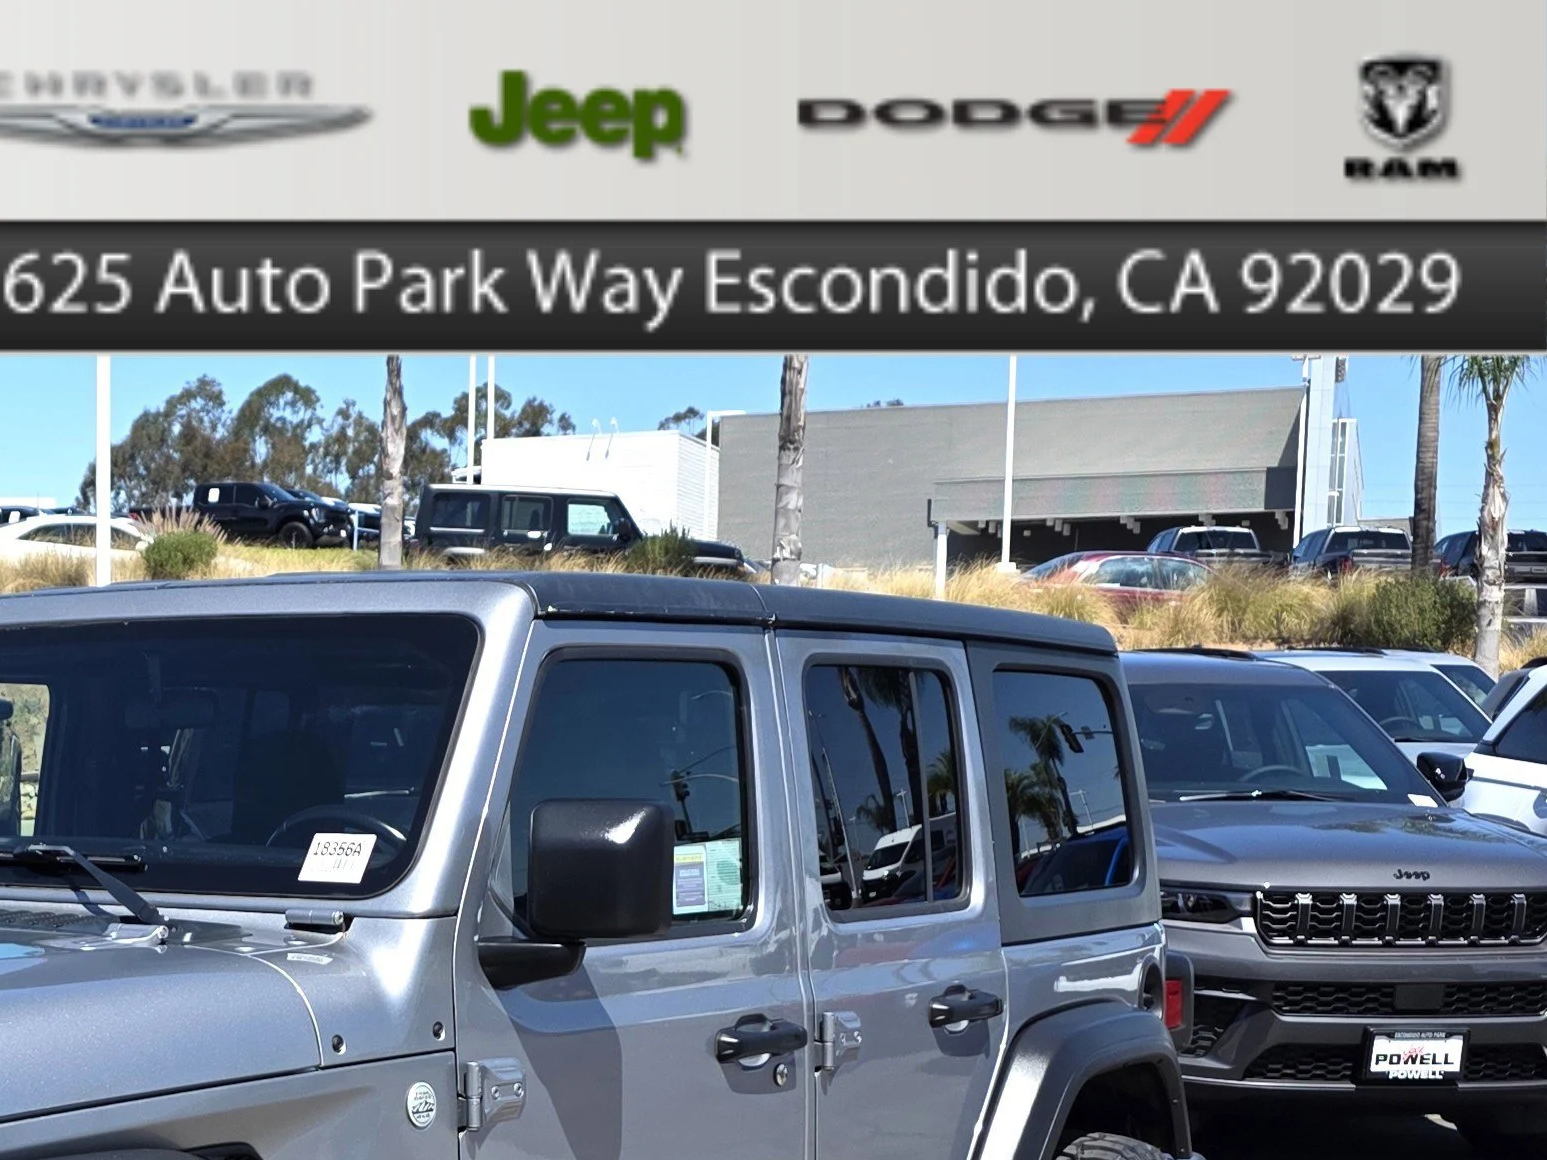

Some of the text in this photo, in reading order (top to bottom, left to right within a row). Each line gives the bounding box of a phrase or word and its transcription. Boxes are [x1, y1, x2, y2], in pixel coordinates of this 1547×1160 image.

[313, 841, 362, 857] 18356A
[1393, 868, 1431, 881] Jeep
[1374, 1053, 1454, 1066] POWELL
[1388, 1069, 1444, 1080] POWELL
